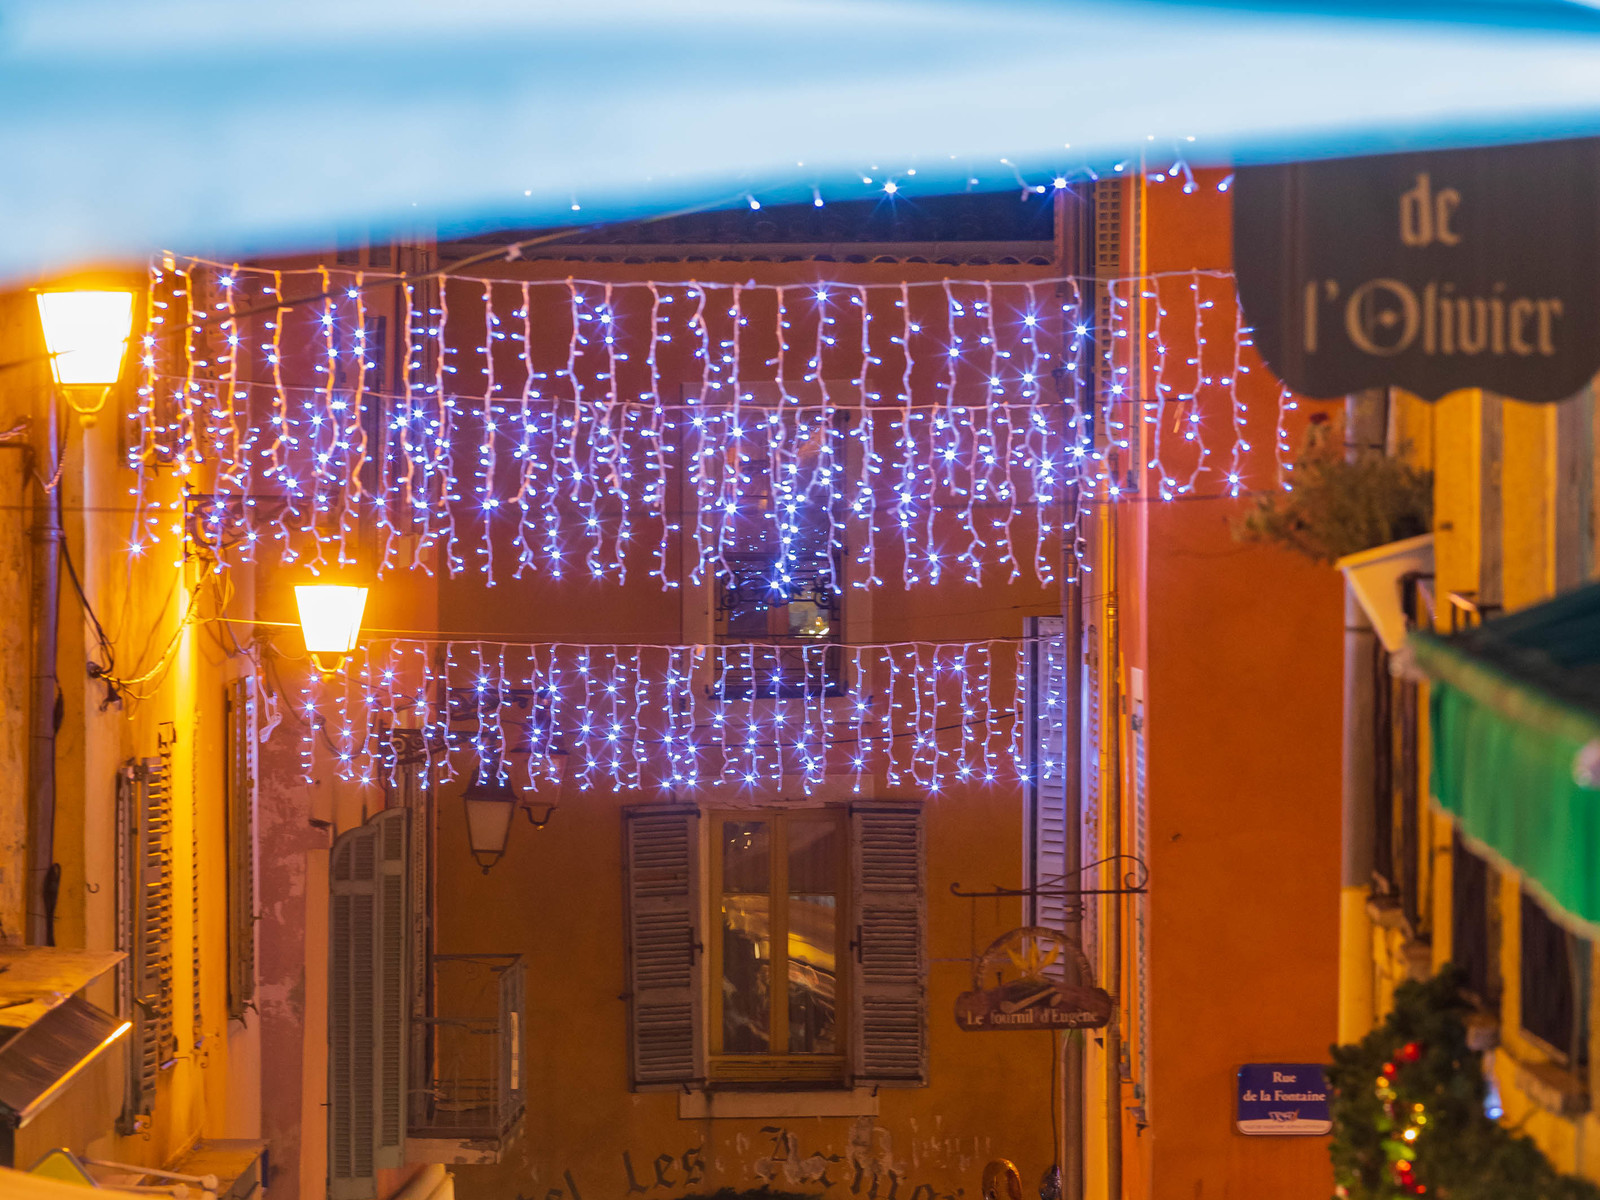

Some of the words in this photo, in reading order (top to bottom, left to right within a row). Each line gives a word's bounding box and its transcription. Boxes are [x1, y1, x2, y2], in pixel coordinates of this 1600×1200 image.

[1400, 172, 1461, 247] de
[1304, 277, 1563, 356] l'Olivier
[966, 1010, 984, 1026] Le
[1272, 1071, 1297, 1083] Rue
[1242, 1089, 1258, 1102] de
[1260, 1089, 1272, 1102] la
[1273, 1089, 1327, 1102] Fontaine
